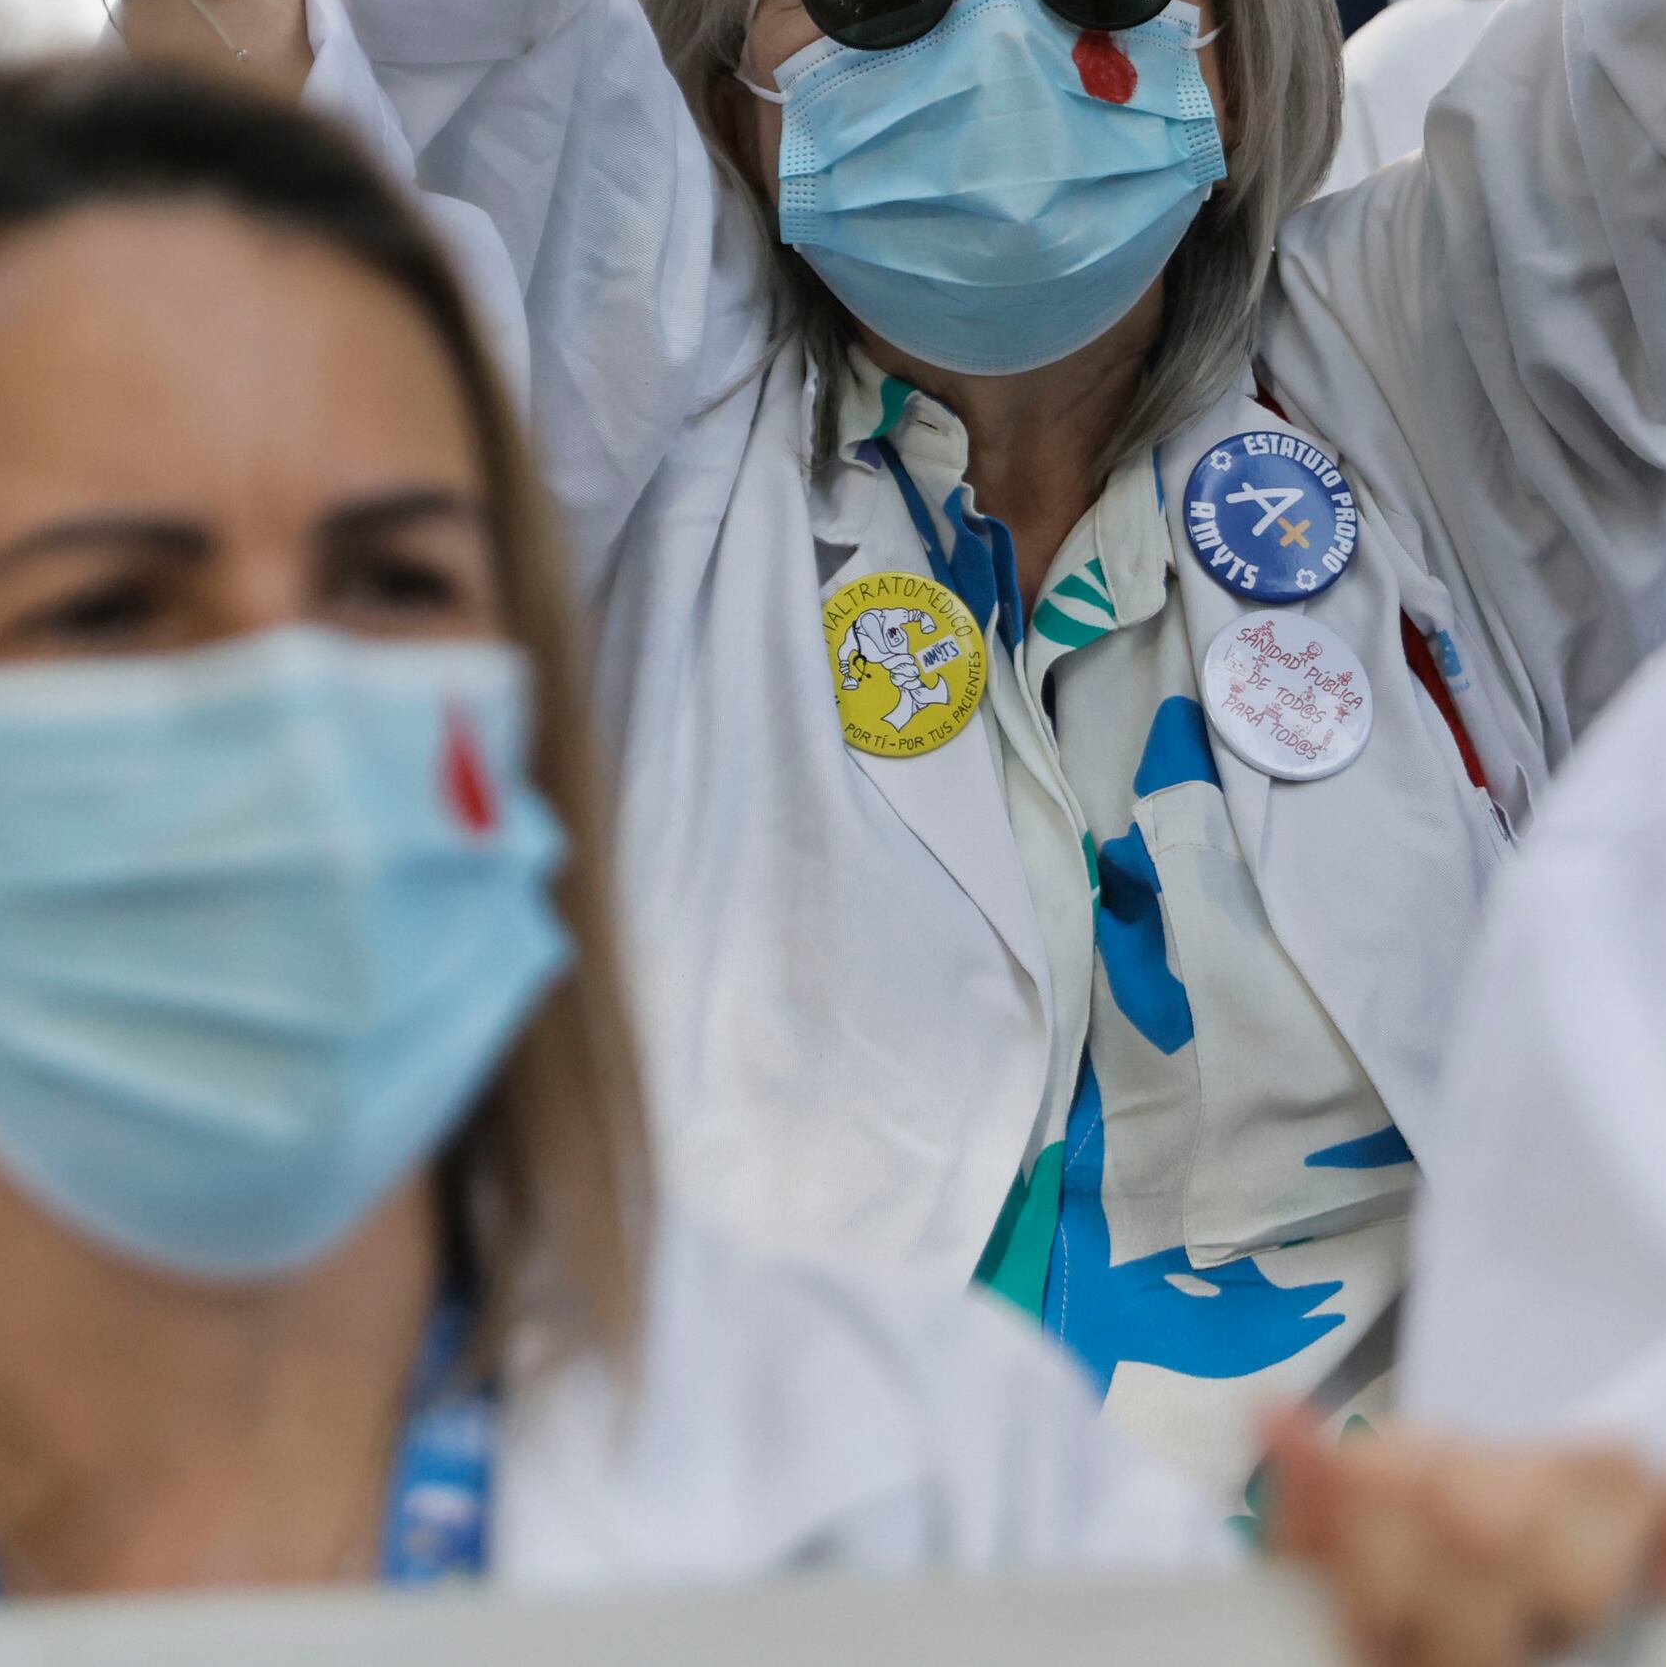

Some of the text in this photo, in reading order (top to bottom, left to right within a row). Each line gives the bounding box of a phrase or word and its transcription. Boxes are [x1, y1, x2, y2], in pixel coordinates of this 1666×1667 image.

[1190, 501, 1259, 590] AMYTS
[1243, 434, 1356, 574] ESTATUTO PROPIO
[845, 723, 870, 744] POR
[898, 736, 925, 750] POR
[927, 721, 953, 743] TUS
[952, 651, 981, 723] PACIENTES
[1236, 628, 1364, 710] SANIDAD PÚBLICA
[1246, 672, 1327, 724] DE TOD@S
[1221, 696, 1322, 760] PARA TOD@S
